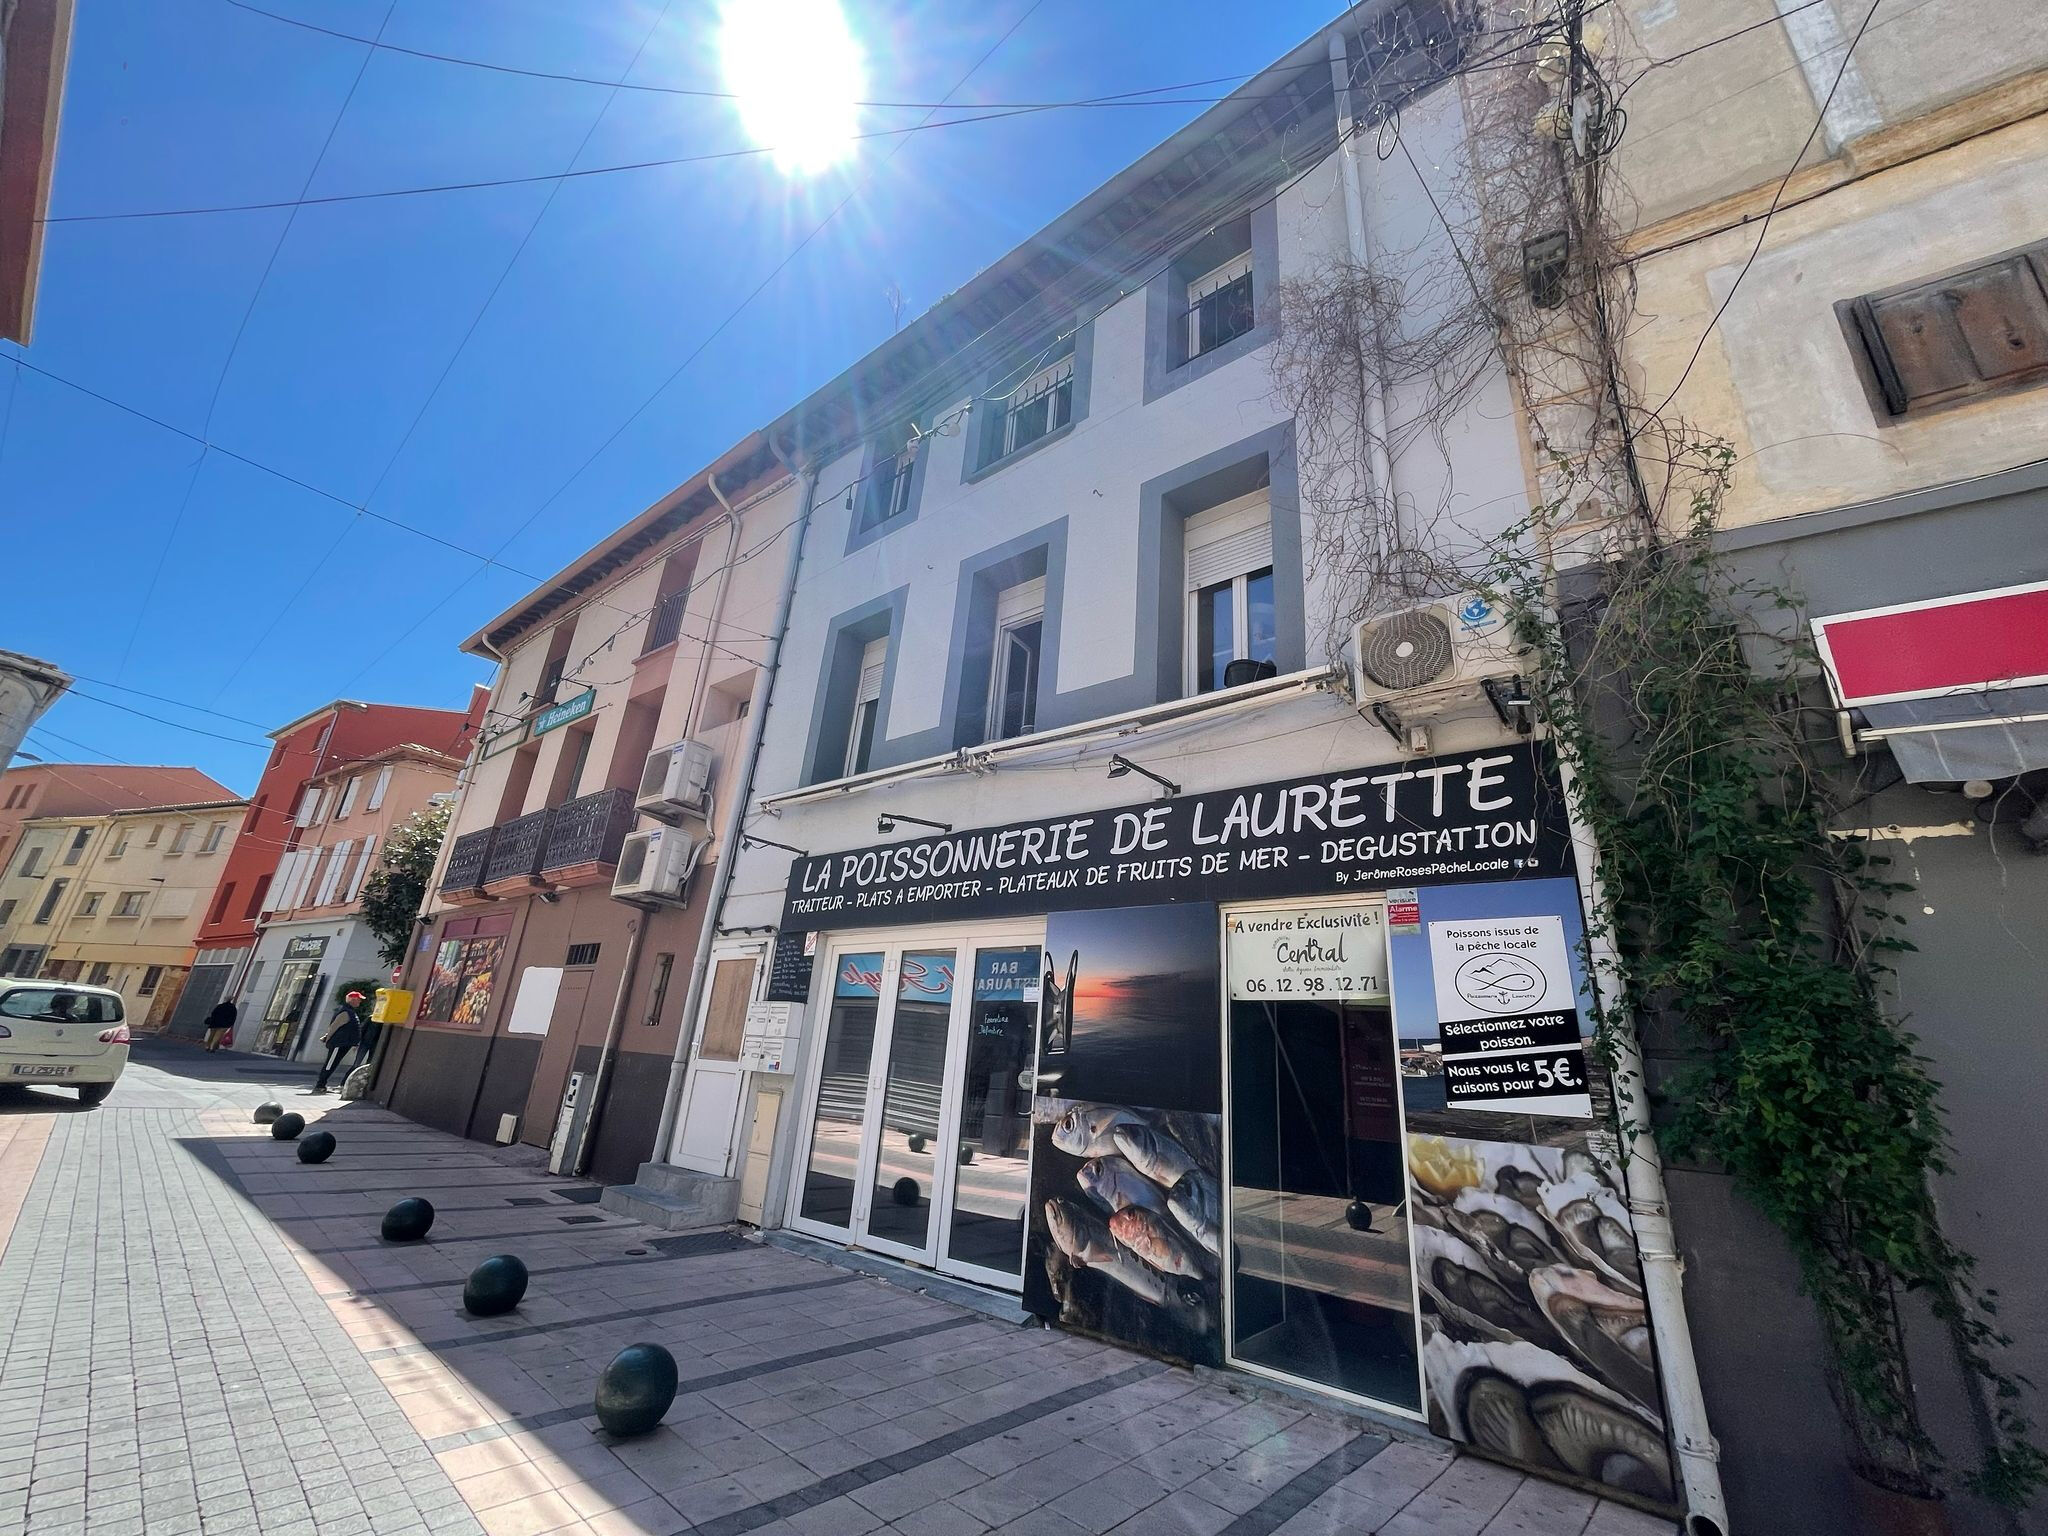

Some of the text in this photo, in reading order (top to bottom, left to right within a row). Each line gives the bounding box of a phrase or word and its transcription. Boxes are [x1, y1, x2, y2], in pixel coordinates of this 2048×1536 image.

[546, 700, 587, 727] Heineken
[802, 755, 1514, 893] LA POISSONNERIE DE LAURETTE
[791, 896, 844, 914] TRAITEUR
[856, 889, 893, 908] PLATS
[895, 891, 903, 905] A
[907, 880, 981, 903] EMPORTER
[999, 868, 1080, 894] PLATEAUX
[1085, 865, 1110, 886] DE
[1117, 857, 1193, 883] FRUITS
[1200, 852, 1230, 875] DE
[1239, 846, 1289, 871] MER
[1320, 819, 1536, 864] DEGUSTATION
[1336, 858, 1509, 885] By JerômeRosesPêcheLocale
[1389, 905, 1418, 913] Alarme
[1234, 920, 1244, 934] A
[1248, 918, 1292, 932] vendre
[1297, 913, 1371, 930] Exclusivité
[1446, 926, 1539, 938] Poissons issus de
[1277, 932, 1349, 964] Central
[1455, 939, 1537, 952] la pêche locale
[1445, 1015, 1565, 1036] Sélectionnez votre
[1480, 1035, 1536, 1050] poisson.
[1448, 1060, 1530, 1077] Nous vous le
[1452, 1082, 1500, 1094] cuisons
[1502, 1079, 1535, 1093] pour
